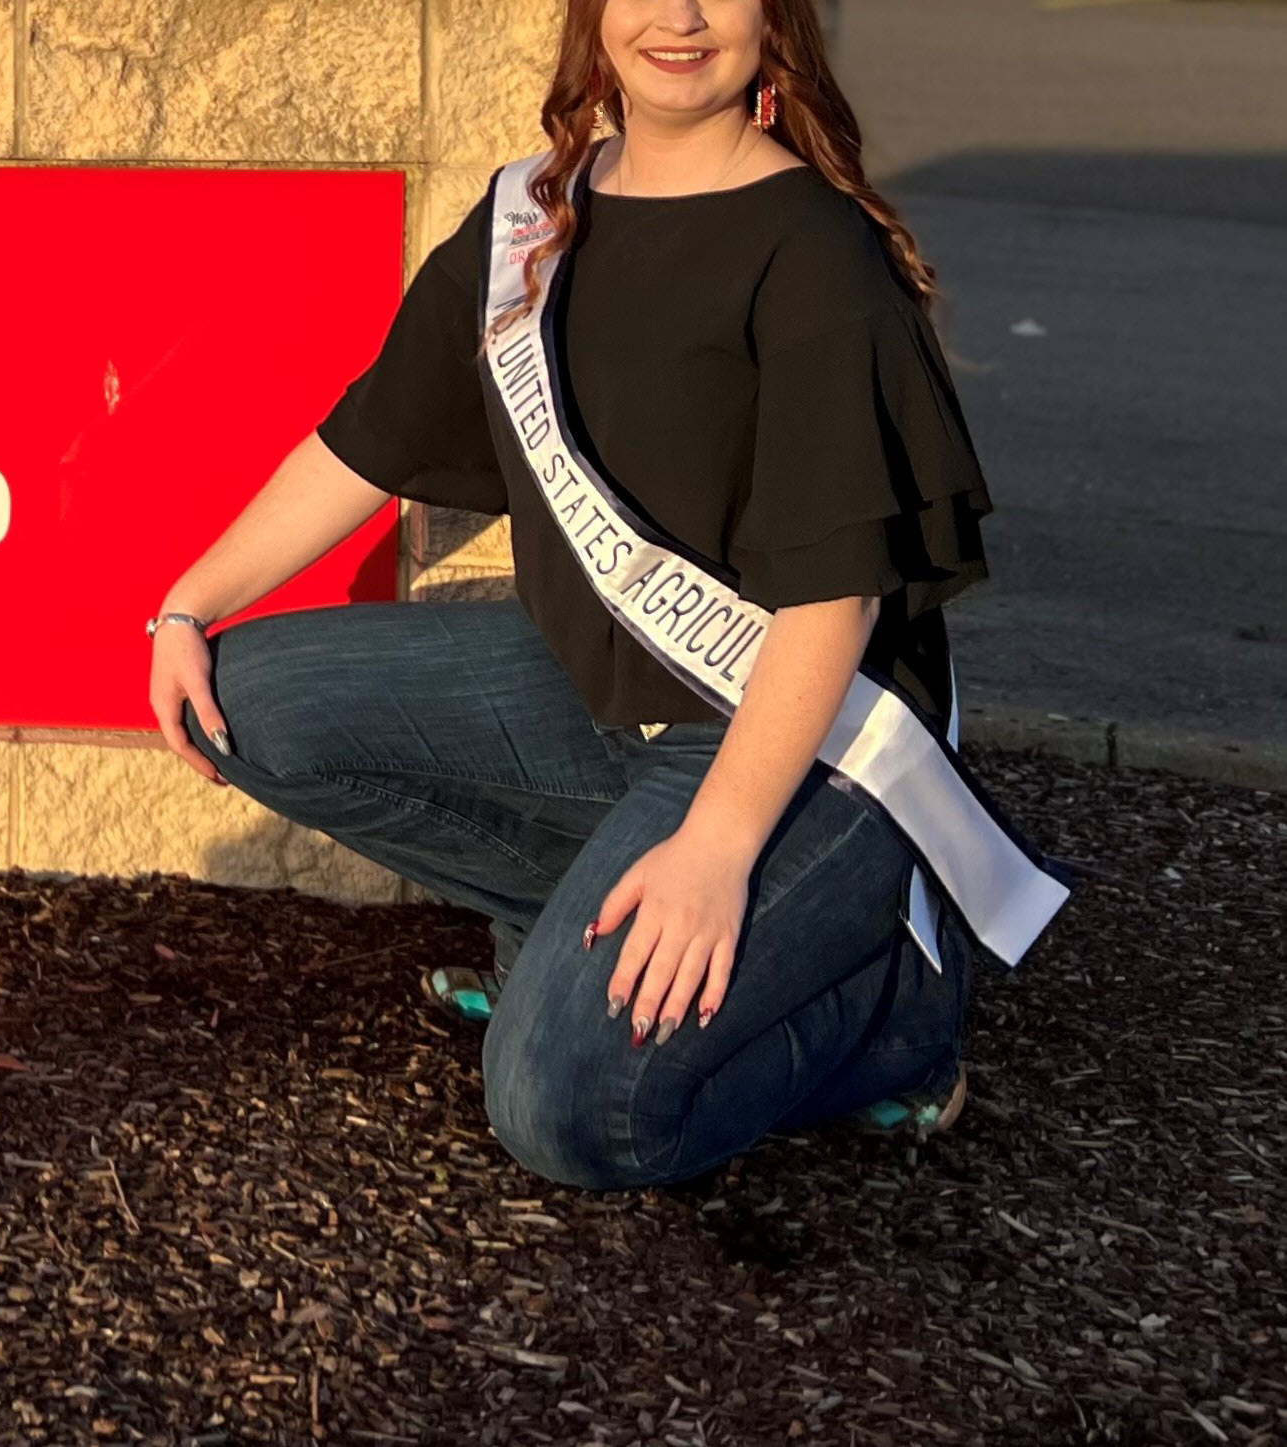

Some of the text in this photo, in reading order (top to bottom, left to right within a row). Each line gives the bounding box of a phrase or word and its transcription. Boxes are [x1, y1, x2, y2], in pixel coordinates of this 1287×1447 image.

[497, 332, 551, 451] UNITED
[543, 453, 633, 575] STATES
[620, 560, 764, 691] AGRICUL
